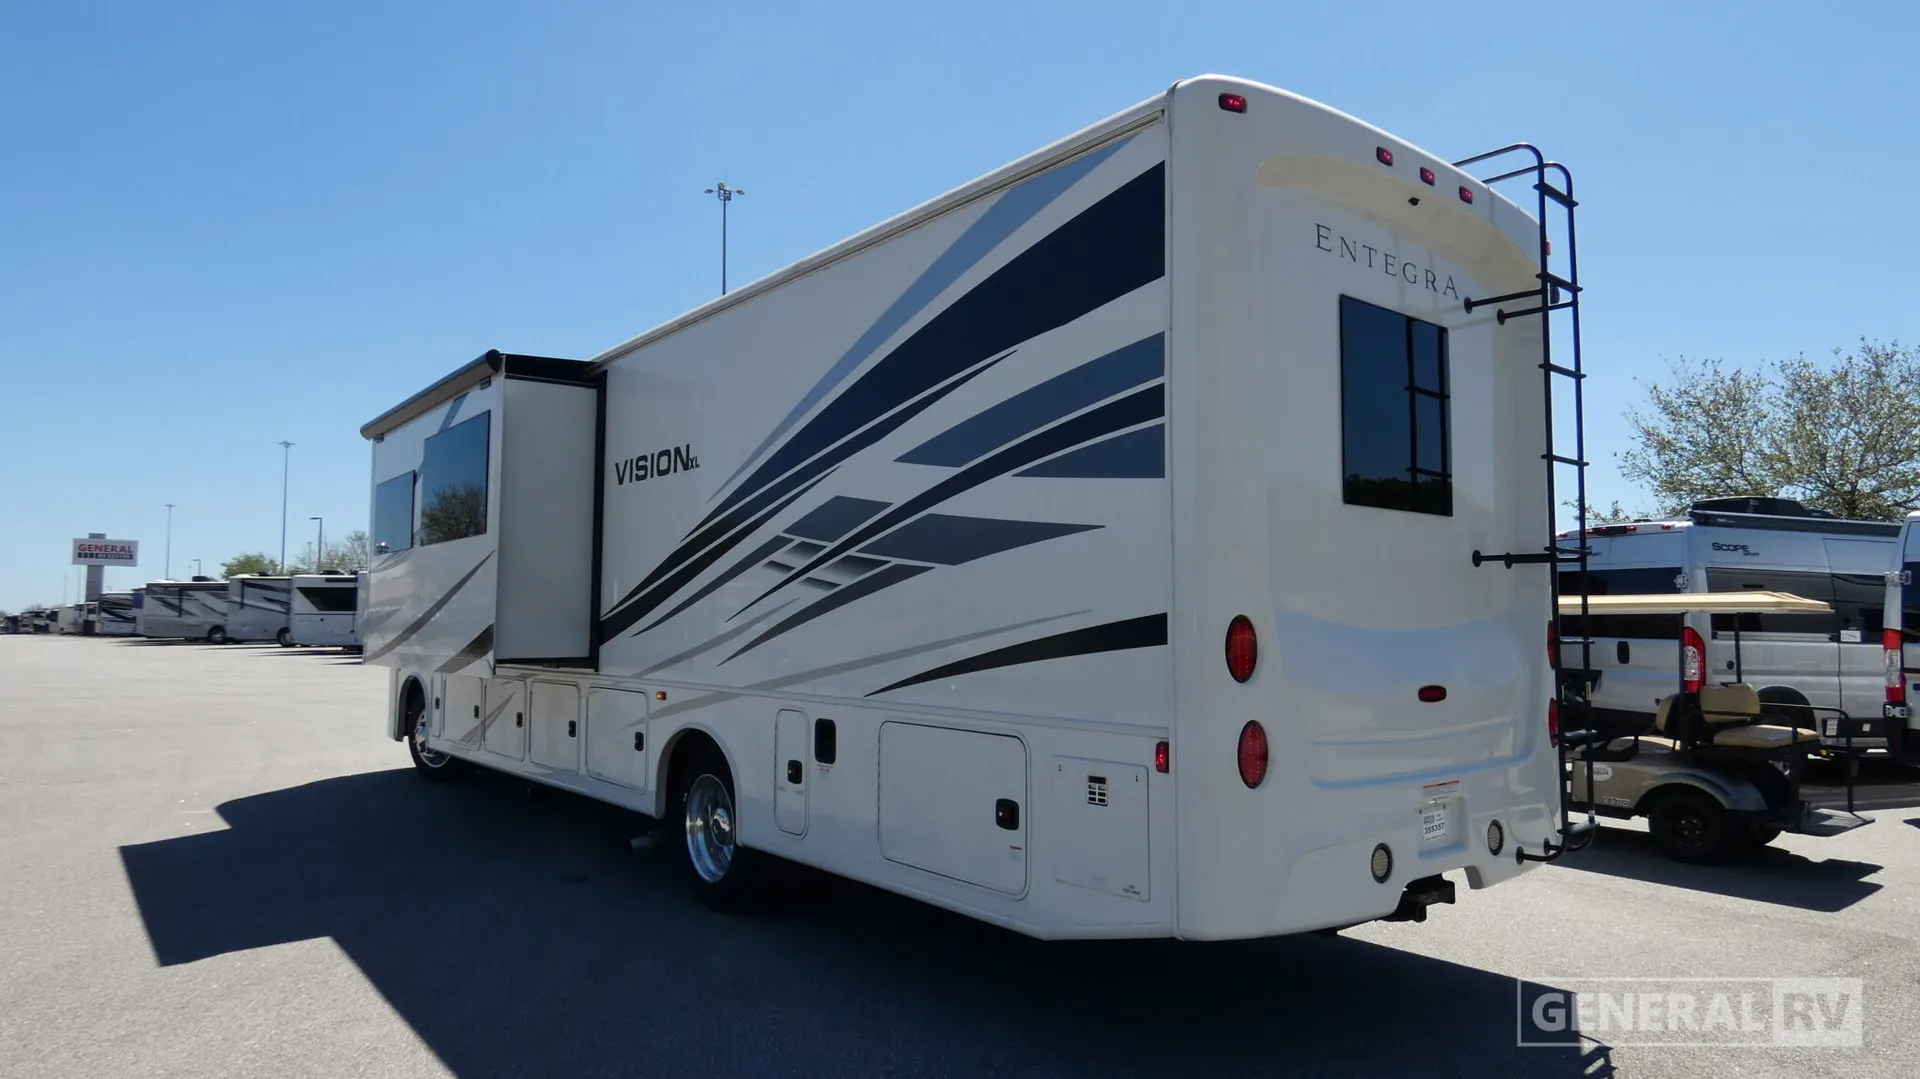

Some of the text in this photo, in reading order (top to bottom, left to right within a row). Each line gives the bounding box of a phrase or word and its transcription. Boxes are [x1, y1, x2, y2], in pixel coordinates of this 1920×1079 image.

[1314, 222, 1459, 300] ENTEGRA
[615, 444, 700, 486] VISION XL
[78, 544, 133, 554] GENERAL
